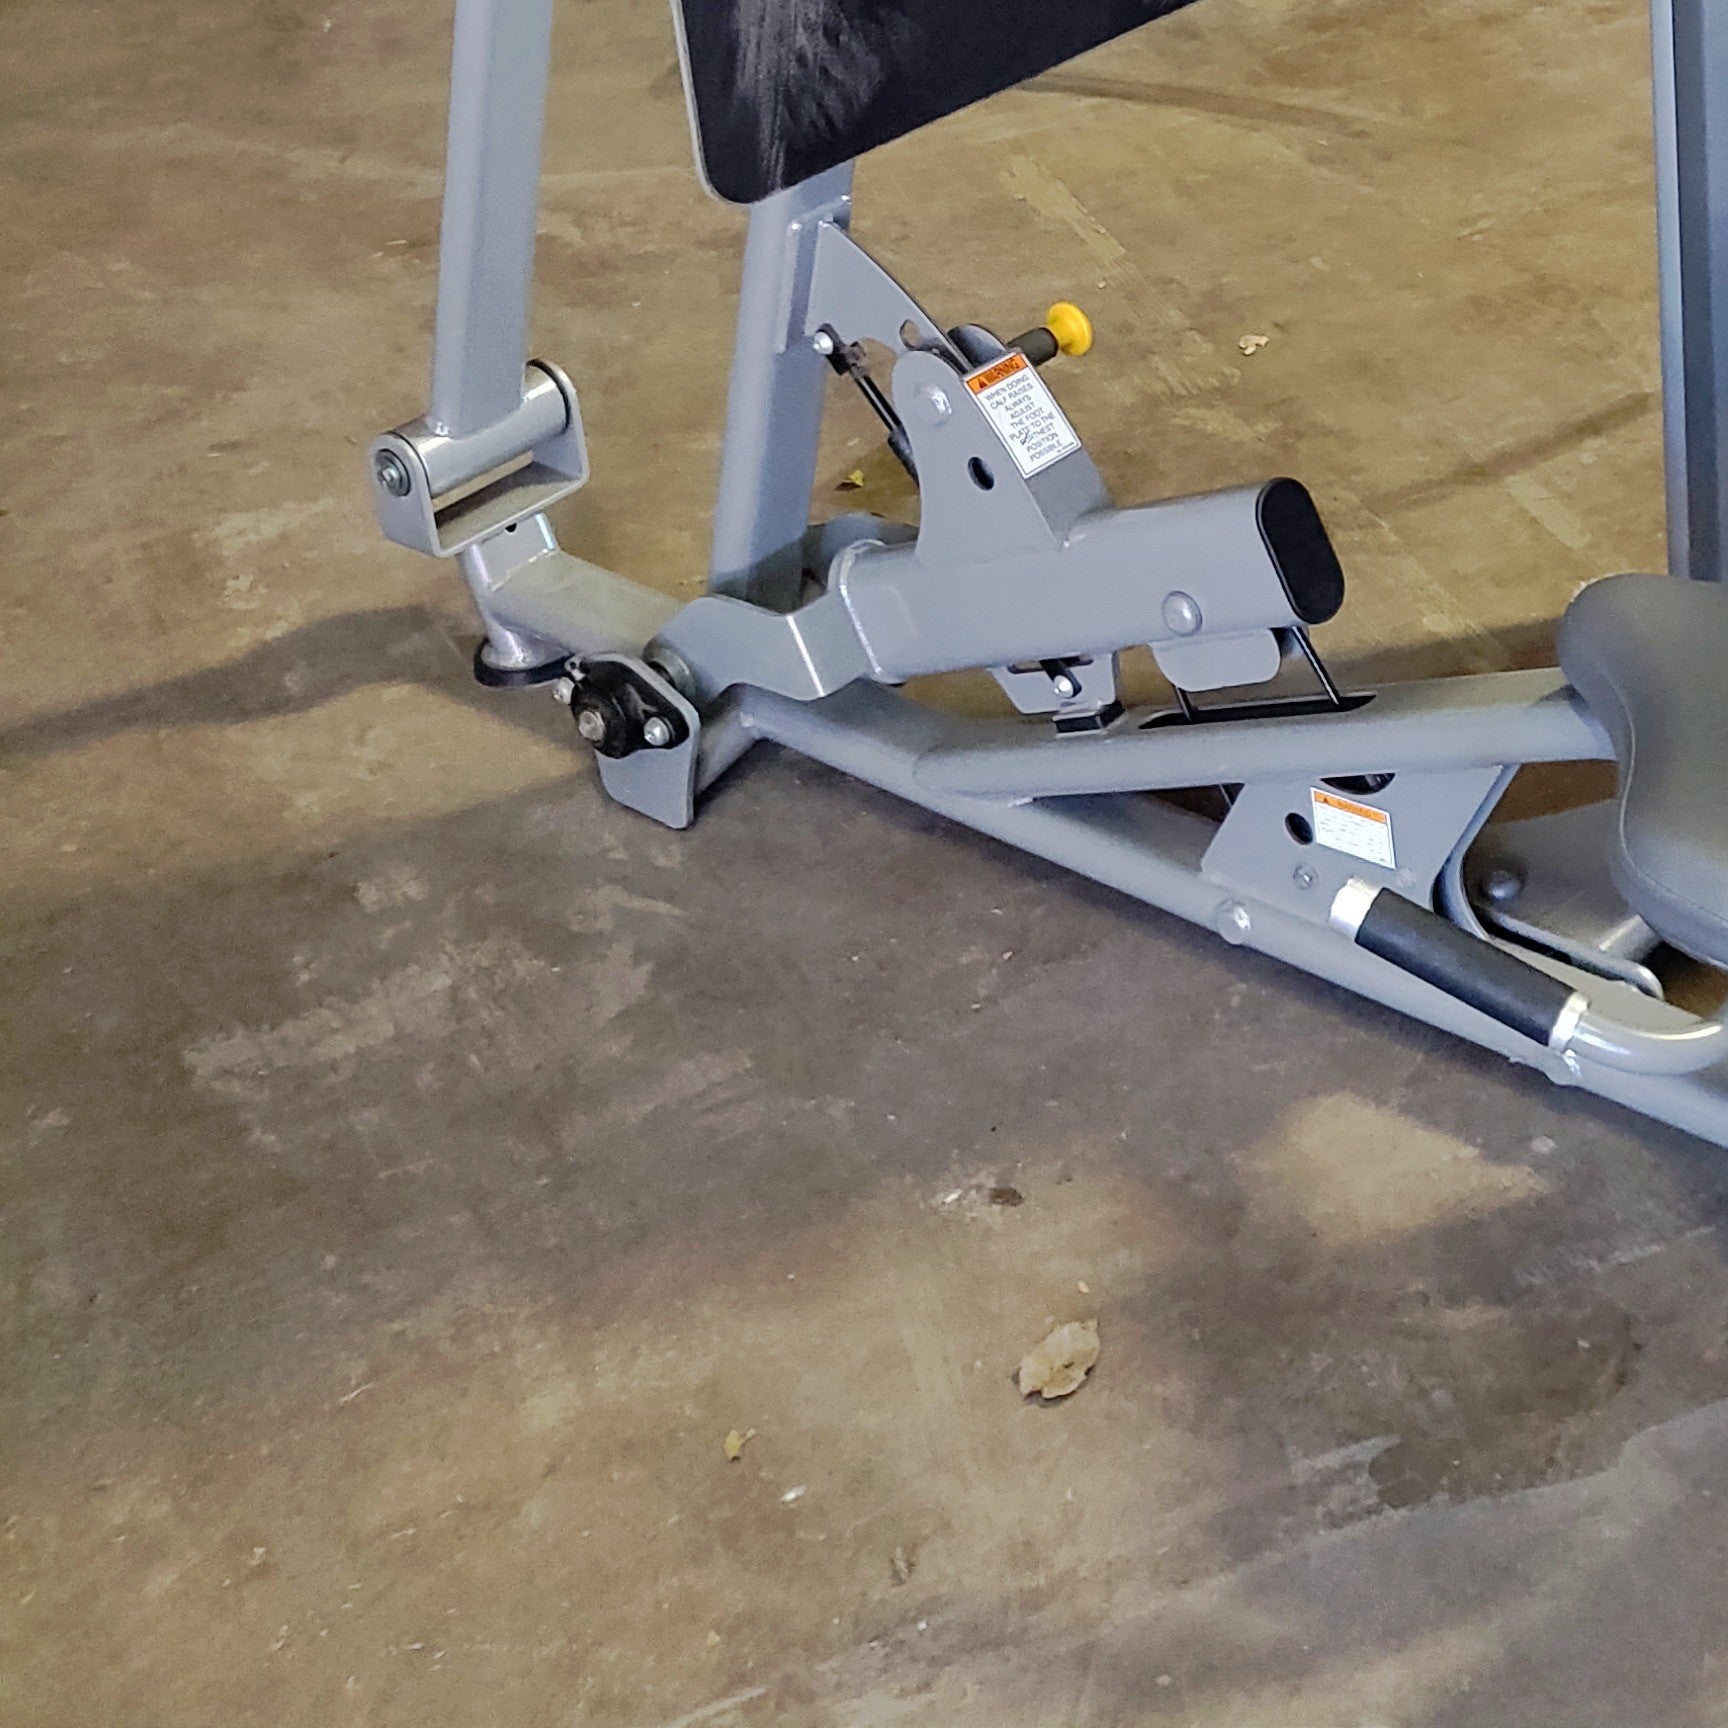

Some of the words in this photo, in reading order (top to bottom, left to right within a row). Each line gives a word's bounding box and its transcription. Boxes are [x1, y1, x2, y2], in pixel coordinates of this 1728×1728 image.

[985, 387, 1008, 402] WHEN
[1006, 374, 1029, 391] DOING
[990, 396, 1008, 410] CALF
[1008, 382, 1034, 399] RAISES
[1004, 394, 1032, 412] ALWAYS
[1010, 401, 1035, 420] ADJUST
[1009, 425, 1030, 441] PLATE
[1030, 420, 1042, 429] TO
[1040, 411, 1056, 423] THE
[1010, 418, 1025, 429] THE
[1025, 406, 1045, 421] FOOT
[1026, 432, 1059, 453] POSITION
